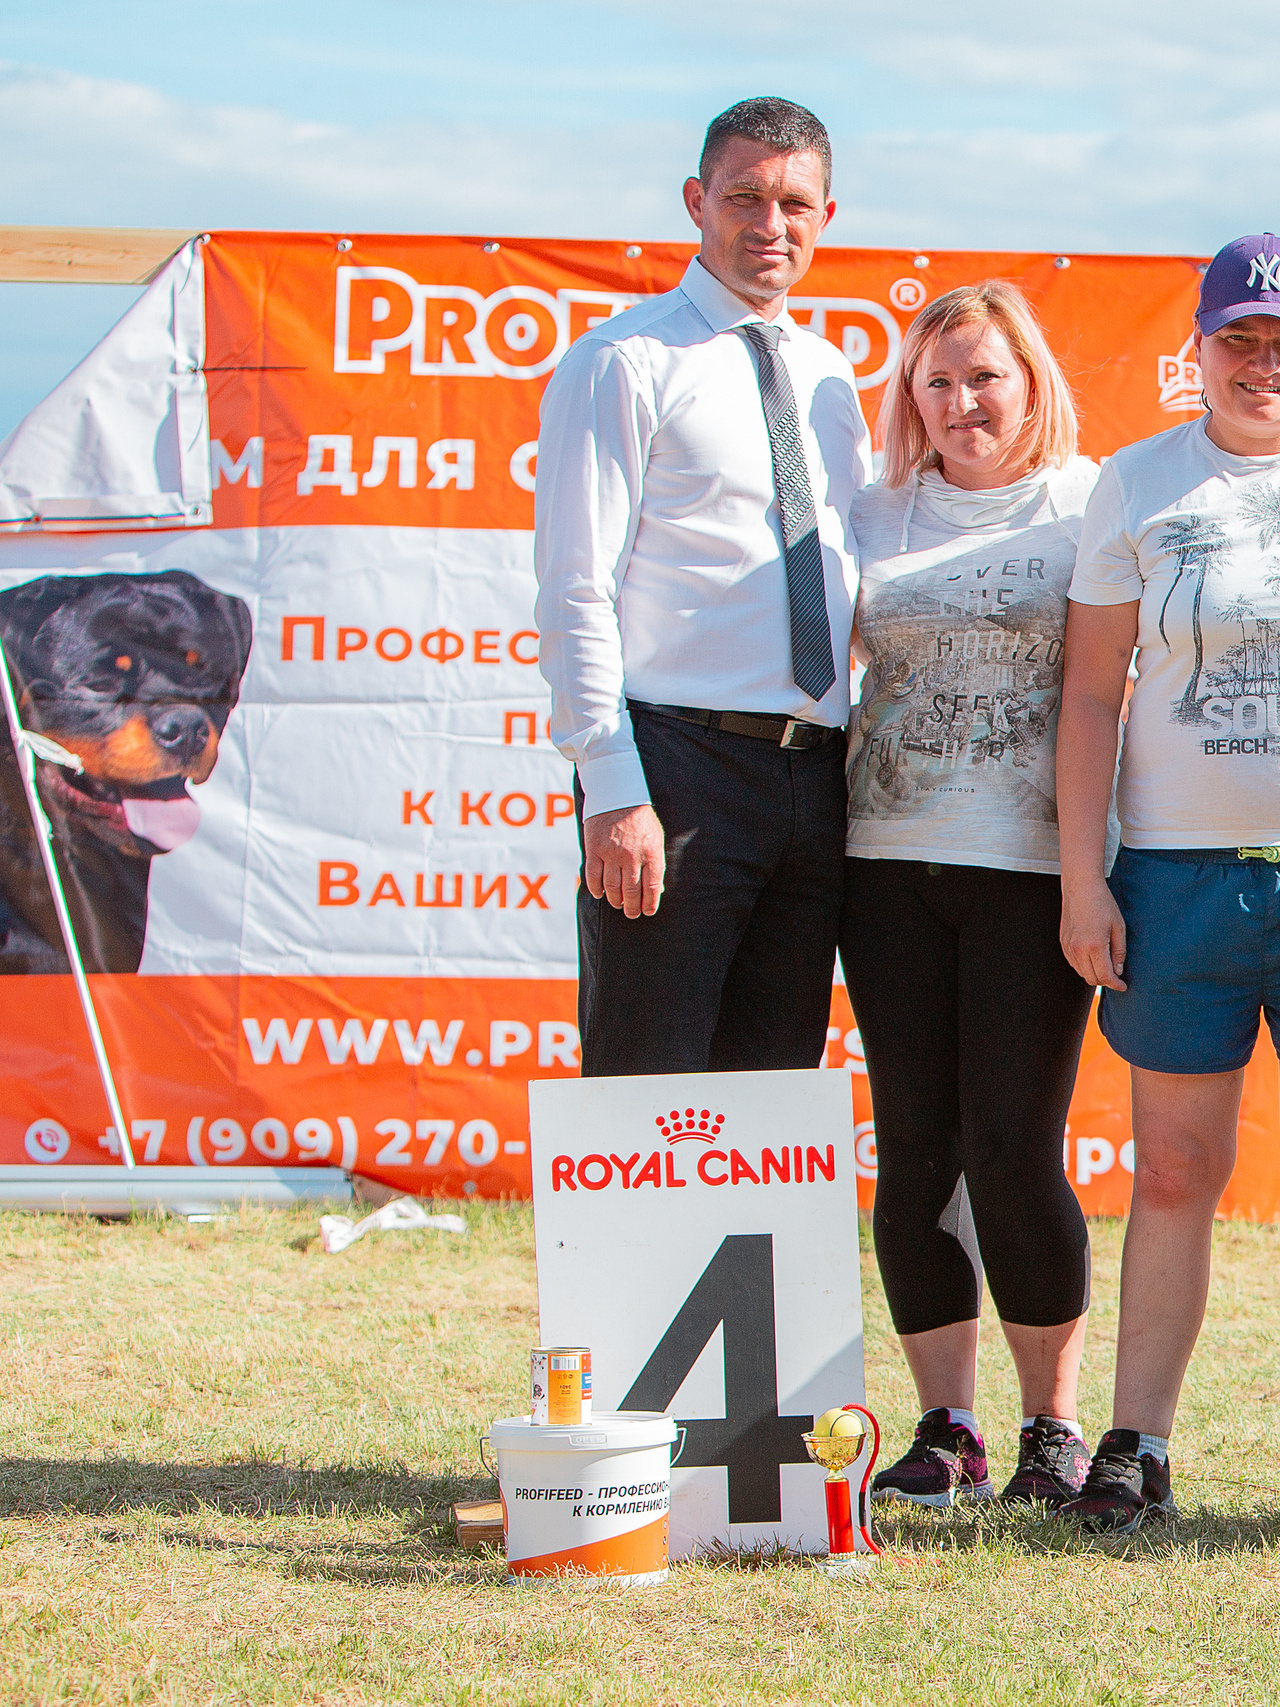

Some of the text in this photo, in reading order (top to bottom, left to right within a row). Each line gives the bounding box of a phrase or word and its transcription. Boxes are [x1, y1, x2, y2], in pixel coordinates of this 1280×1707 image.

[1204, 738, 1268, 756] BEACH
[187, 1115, 358, 1167] (909)
[551, 1150, 687, 1193] ROYAL
[696, 1144, 836, 1186] CANIN
[617, 1233, 816, 1525] 4
[515, 1487, 584, 1501] PROFIFEED
[585, 1498, 664, 1518] КОРМЛЕНИЮ
